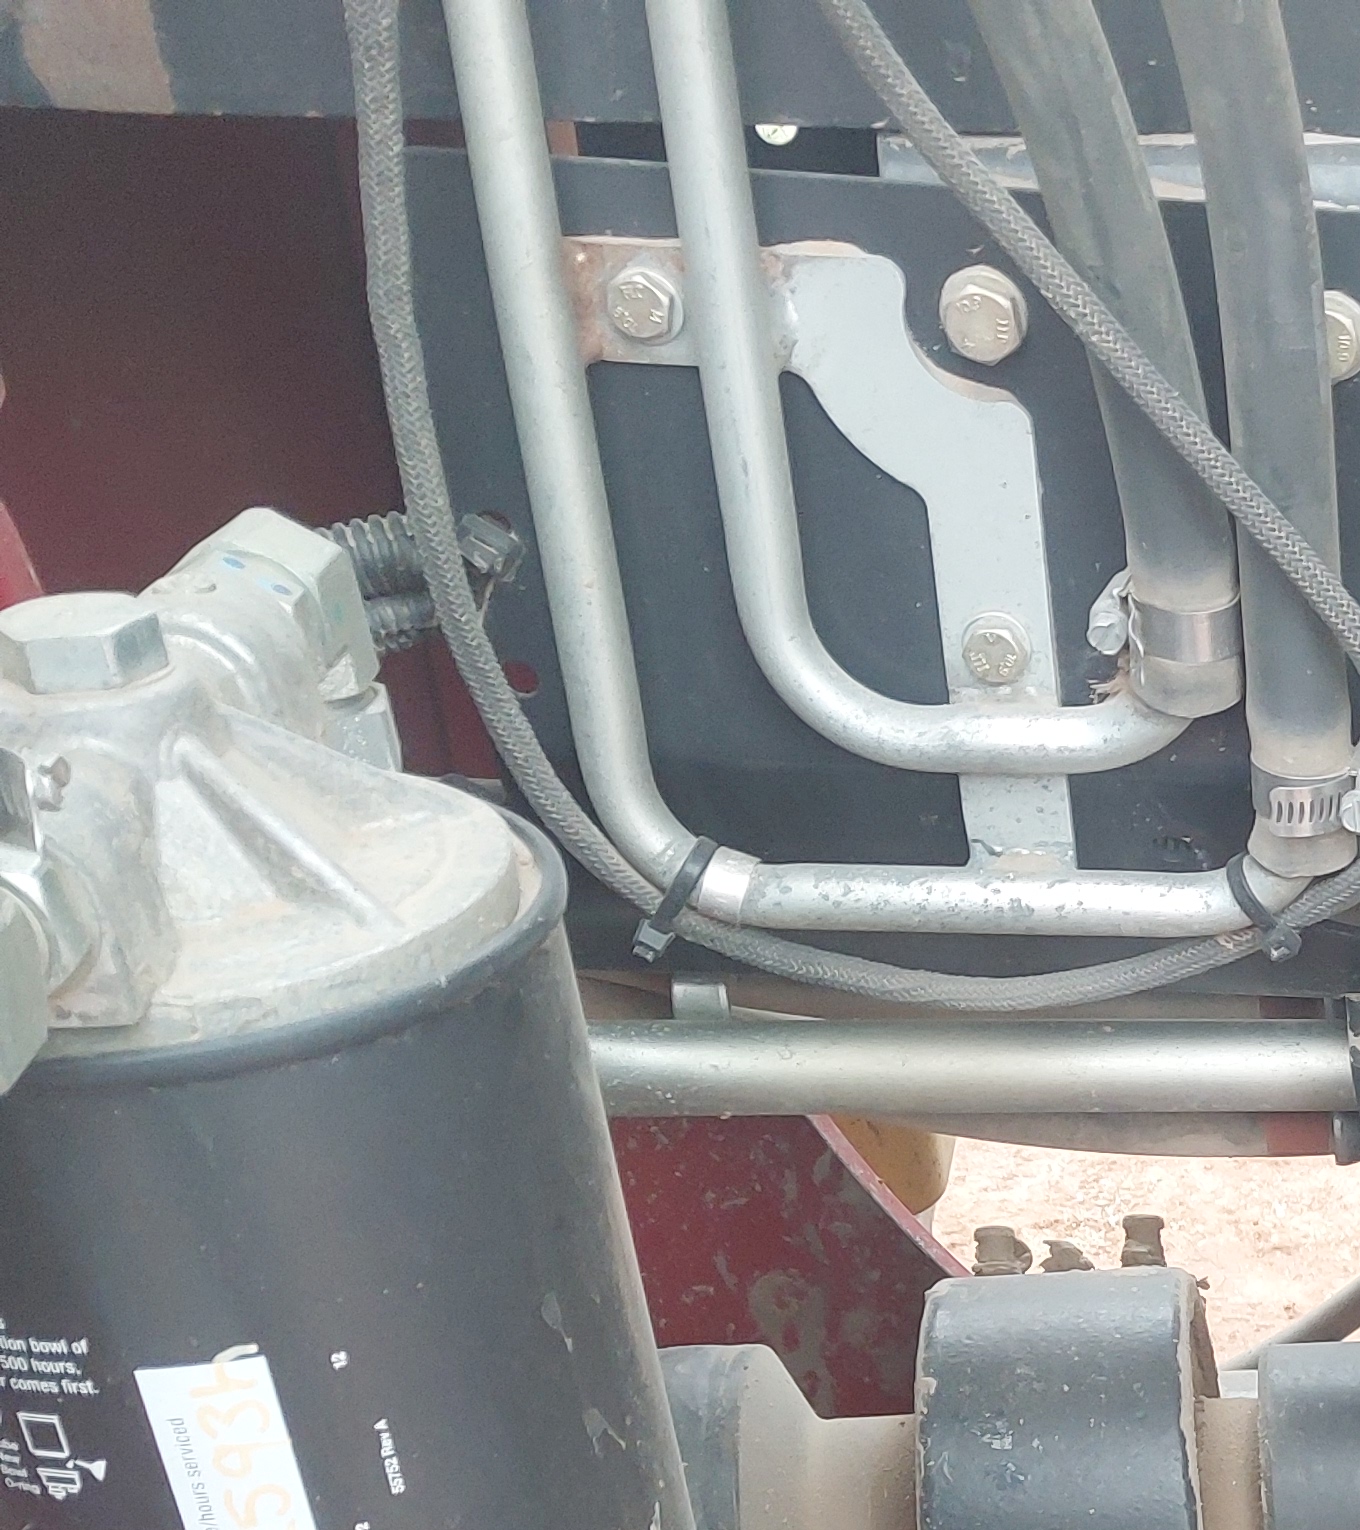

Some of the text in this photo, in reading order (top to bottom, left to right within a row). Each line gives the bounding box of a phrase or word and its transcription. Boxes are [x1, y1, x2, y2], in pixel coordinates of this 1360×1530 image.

[28, 1337, 69, 1355] bowl
[71, 1337, 89, 1355] of
[30, 1358, 82, 1376] hours.
[331, 1351, 348, 1370] 12
[9, 1378, 59, 1394] comes
[61, 1378, 100, 1396] first.
[166, 1417, 201, 1478] serviced
[373, 1417, 406, 1496] 55752 Rev A
